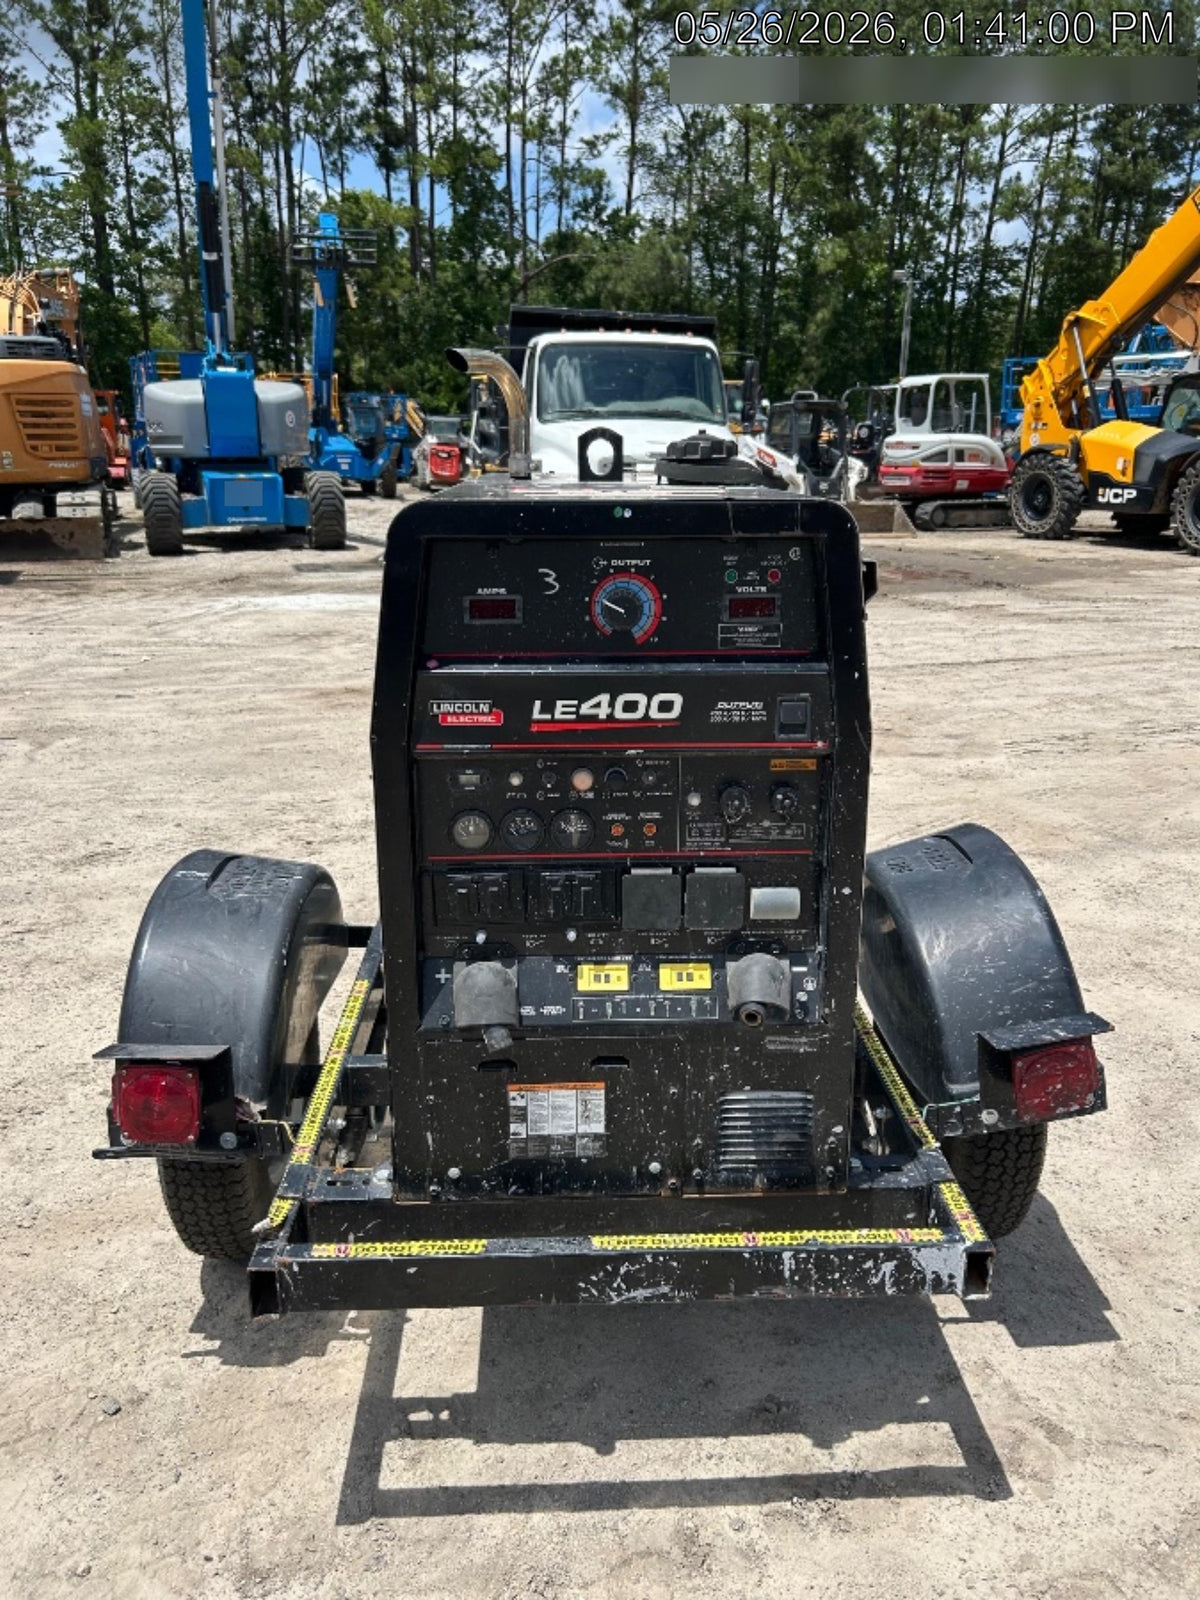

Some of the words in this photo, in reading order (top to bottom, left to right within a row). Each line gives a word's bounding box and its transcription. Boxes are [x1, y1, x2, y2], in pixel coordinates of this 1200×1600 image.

[610, 559, 652, 567] OUTPUT
[538, 568, 560, 595] 3
[432, 702, 490, 714] LINCOLN
[531, 692, 684, 721] LE400
[446, 714, 497, 724] ELECTRIC
[417, 1243, 471, 1252] STAND
